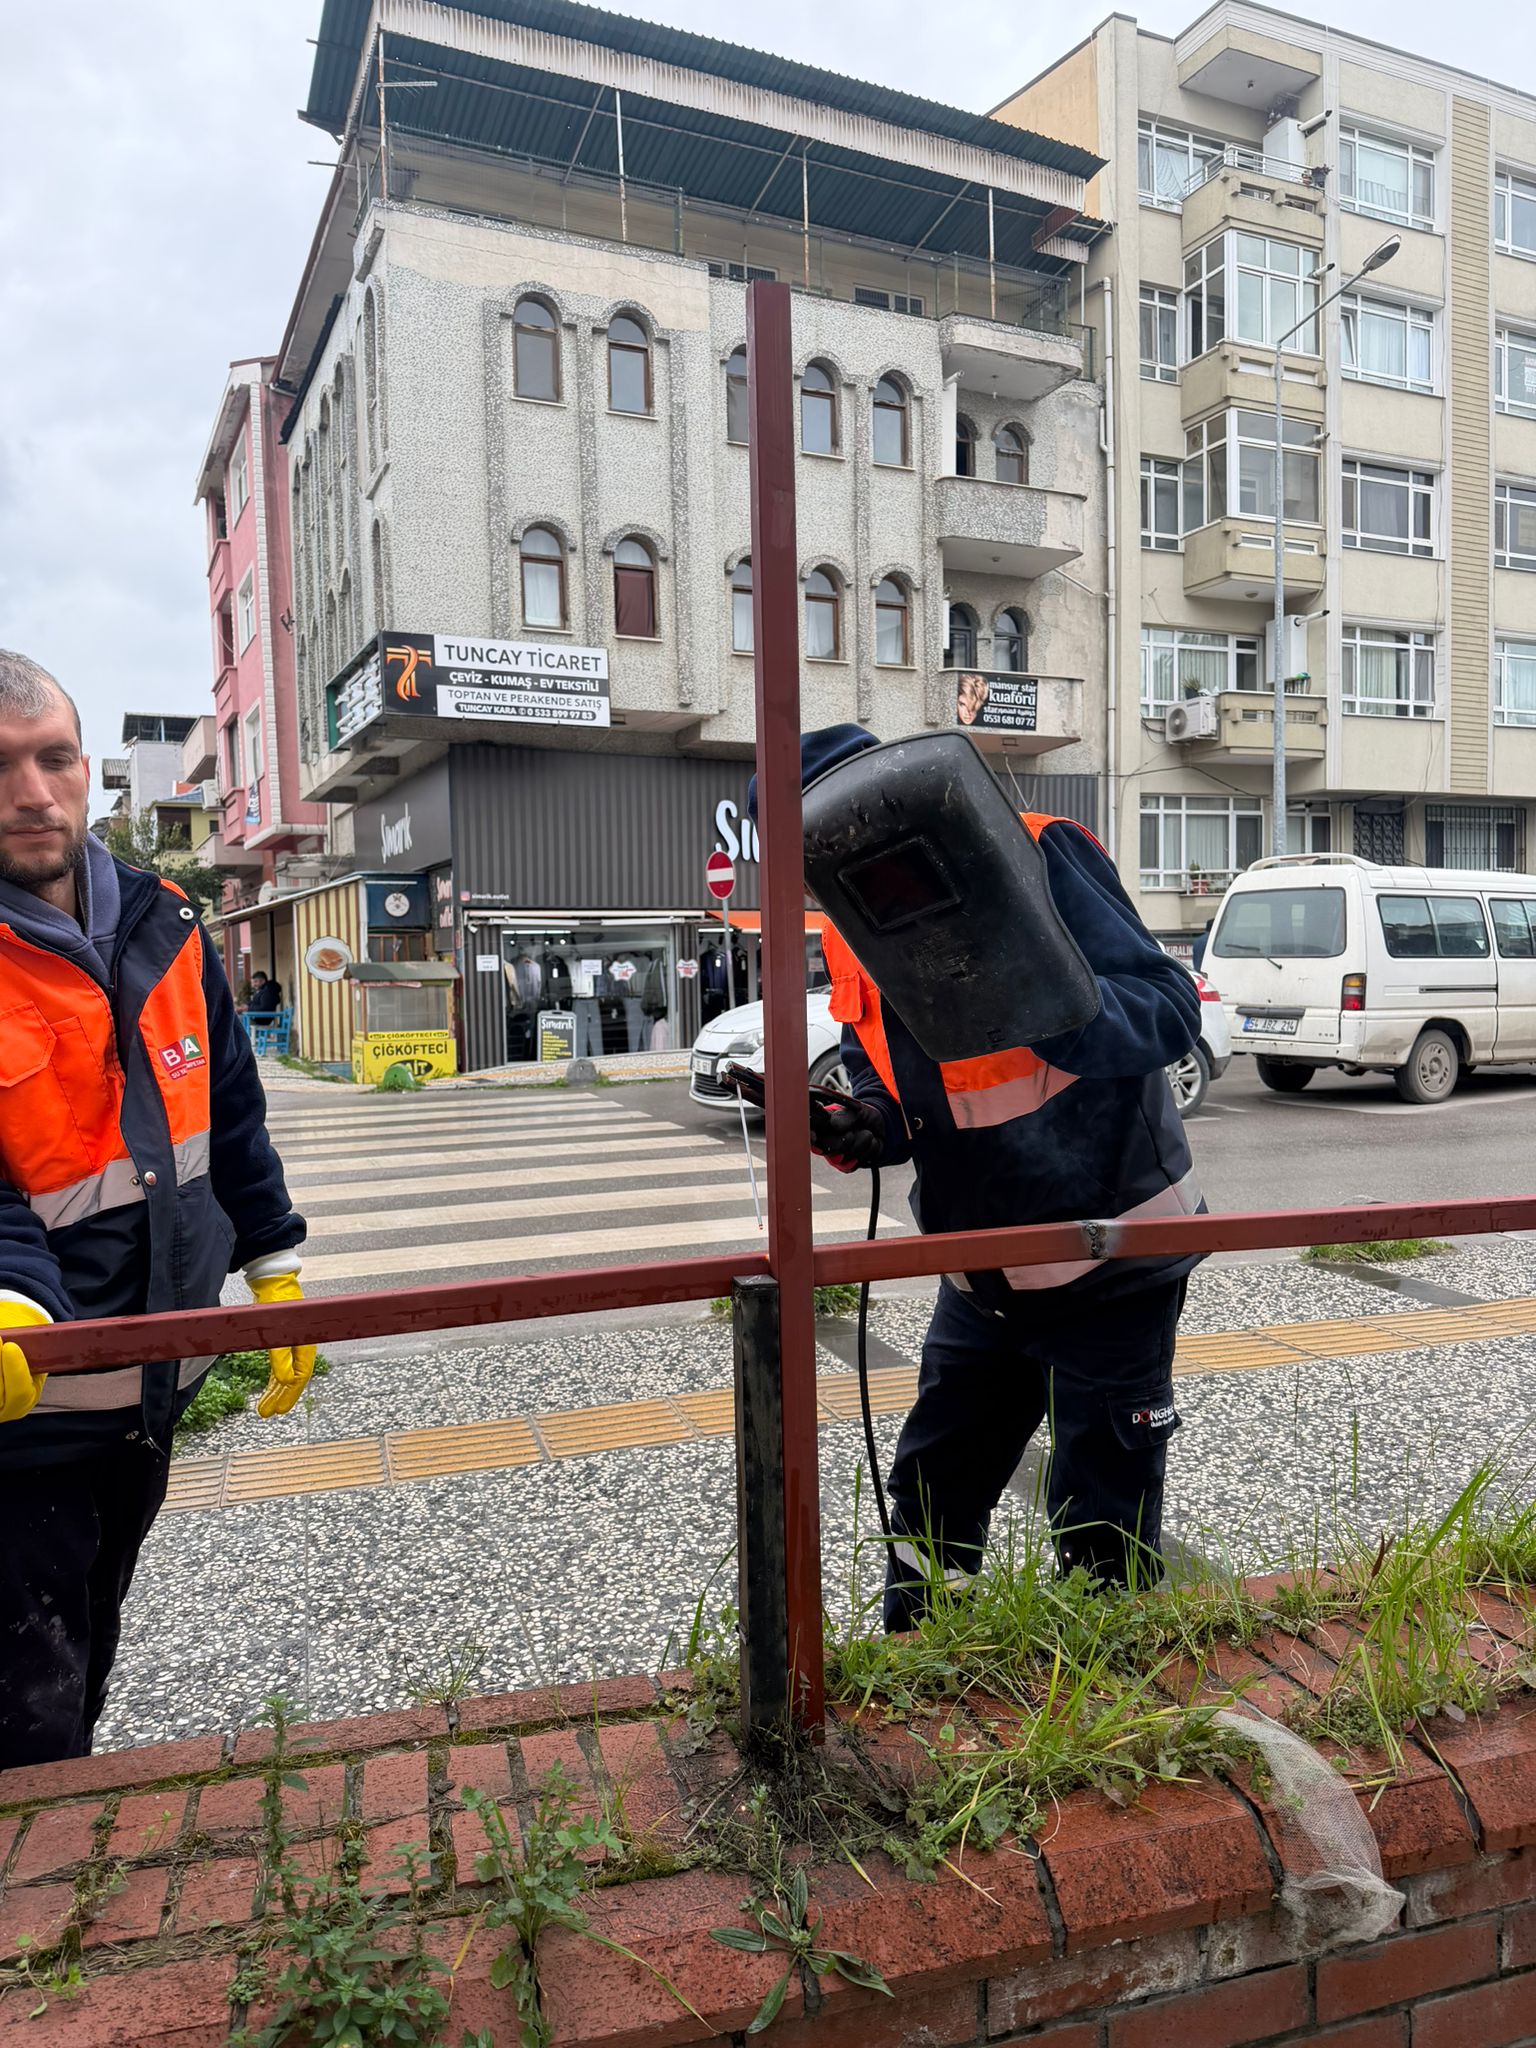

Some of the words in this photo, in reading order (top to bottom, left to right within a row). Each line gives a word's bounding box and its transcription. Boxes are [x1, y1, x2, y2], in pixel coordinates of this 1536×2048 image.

[444, 644, 522, 665] TUNCAY
[527, 648, 601, 672] TİCARET
[449, 671, 482, 684] ÇEYİZ
[491, 674, 532, 690] KUMAŞ
[540, 679, 554, 689] EV
[555, 679, 599, 692] TEKSTİLİ
[448, 689, 491, 701] TOPTAN
[493, 692, 508, 702] VE
[510, 694, 573, 706] PERAKENDE
[575, 699, 602, 710] SATIŞ
[459, 703, 492, 713] TUNCAY
[493, 706, 517, 715] KARA
[535, 708, 551, 717] 533
[373, 1041, 448, 1059] ÇİĞKÖFTECİ
